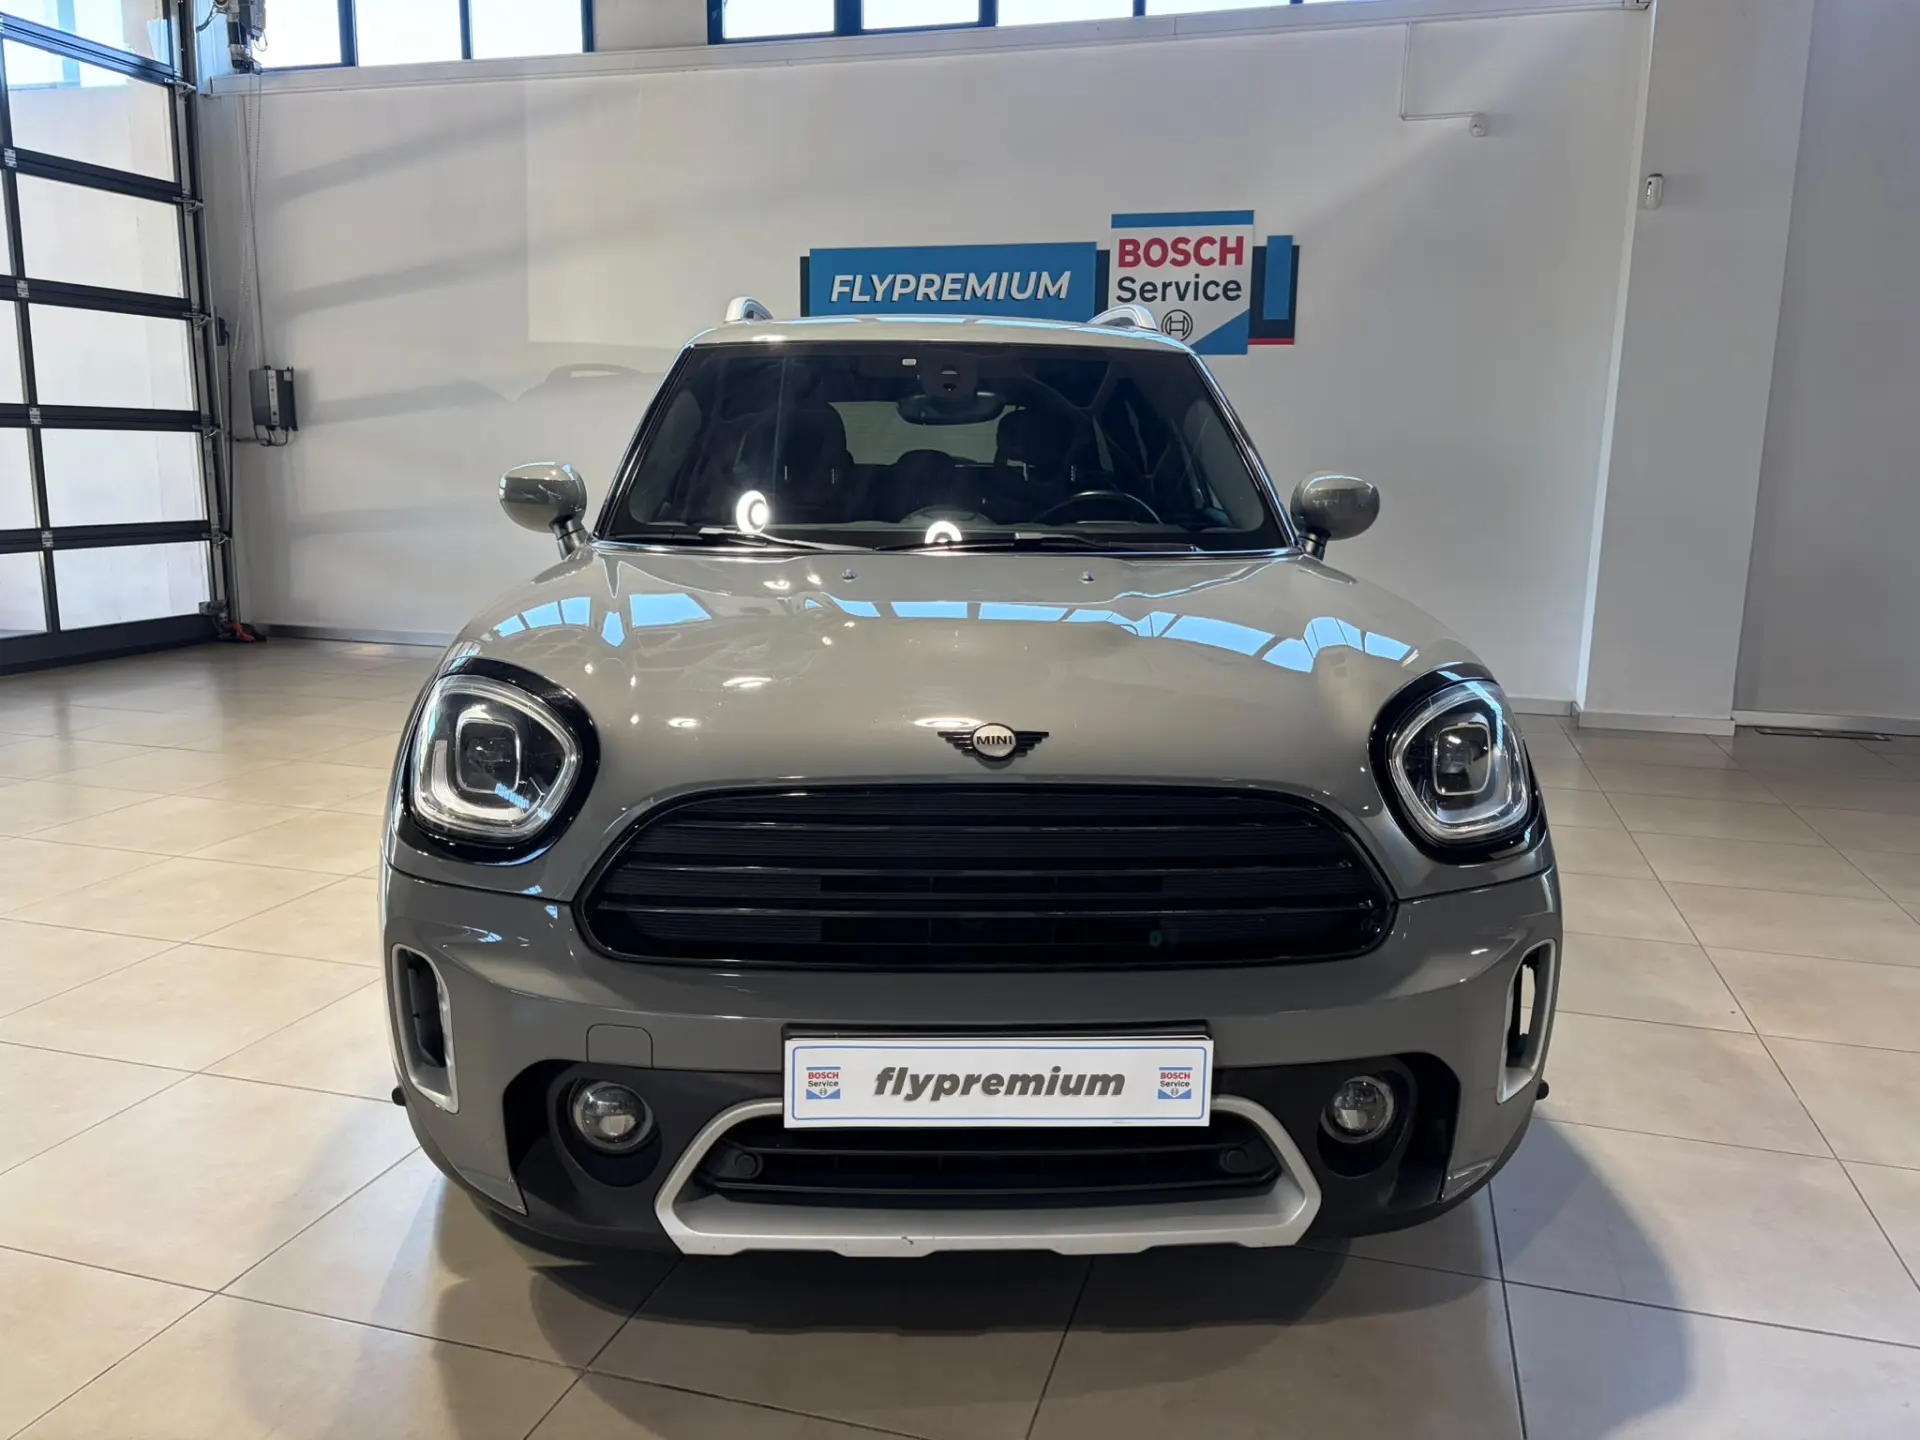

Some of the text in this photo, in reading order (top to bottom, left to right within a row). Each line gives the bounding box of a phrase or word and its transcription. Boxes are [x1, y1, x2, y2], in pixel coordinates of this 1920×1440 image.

[1117, 235, 1244, 268] BOSCH
[830, 271, 1072, 303] FLYPREMIUM
[1116, 273, 1242, 303] Service
[976, 735, 1013, 745] MINI
[808, 1072, 839, 1080] BOSCH
[1160, 1072, 1191, 1080] BOSCH
[808, 1080, 839, 1088] Service
[873, 1065, 1125, 1102] flypremium
[1160, 1080, 1190, 1088] Service
